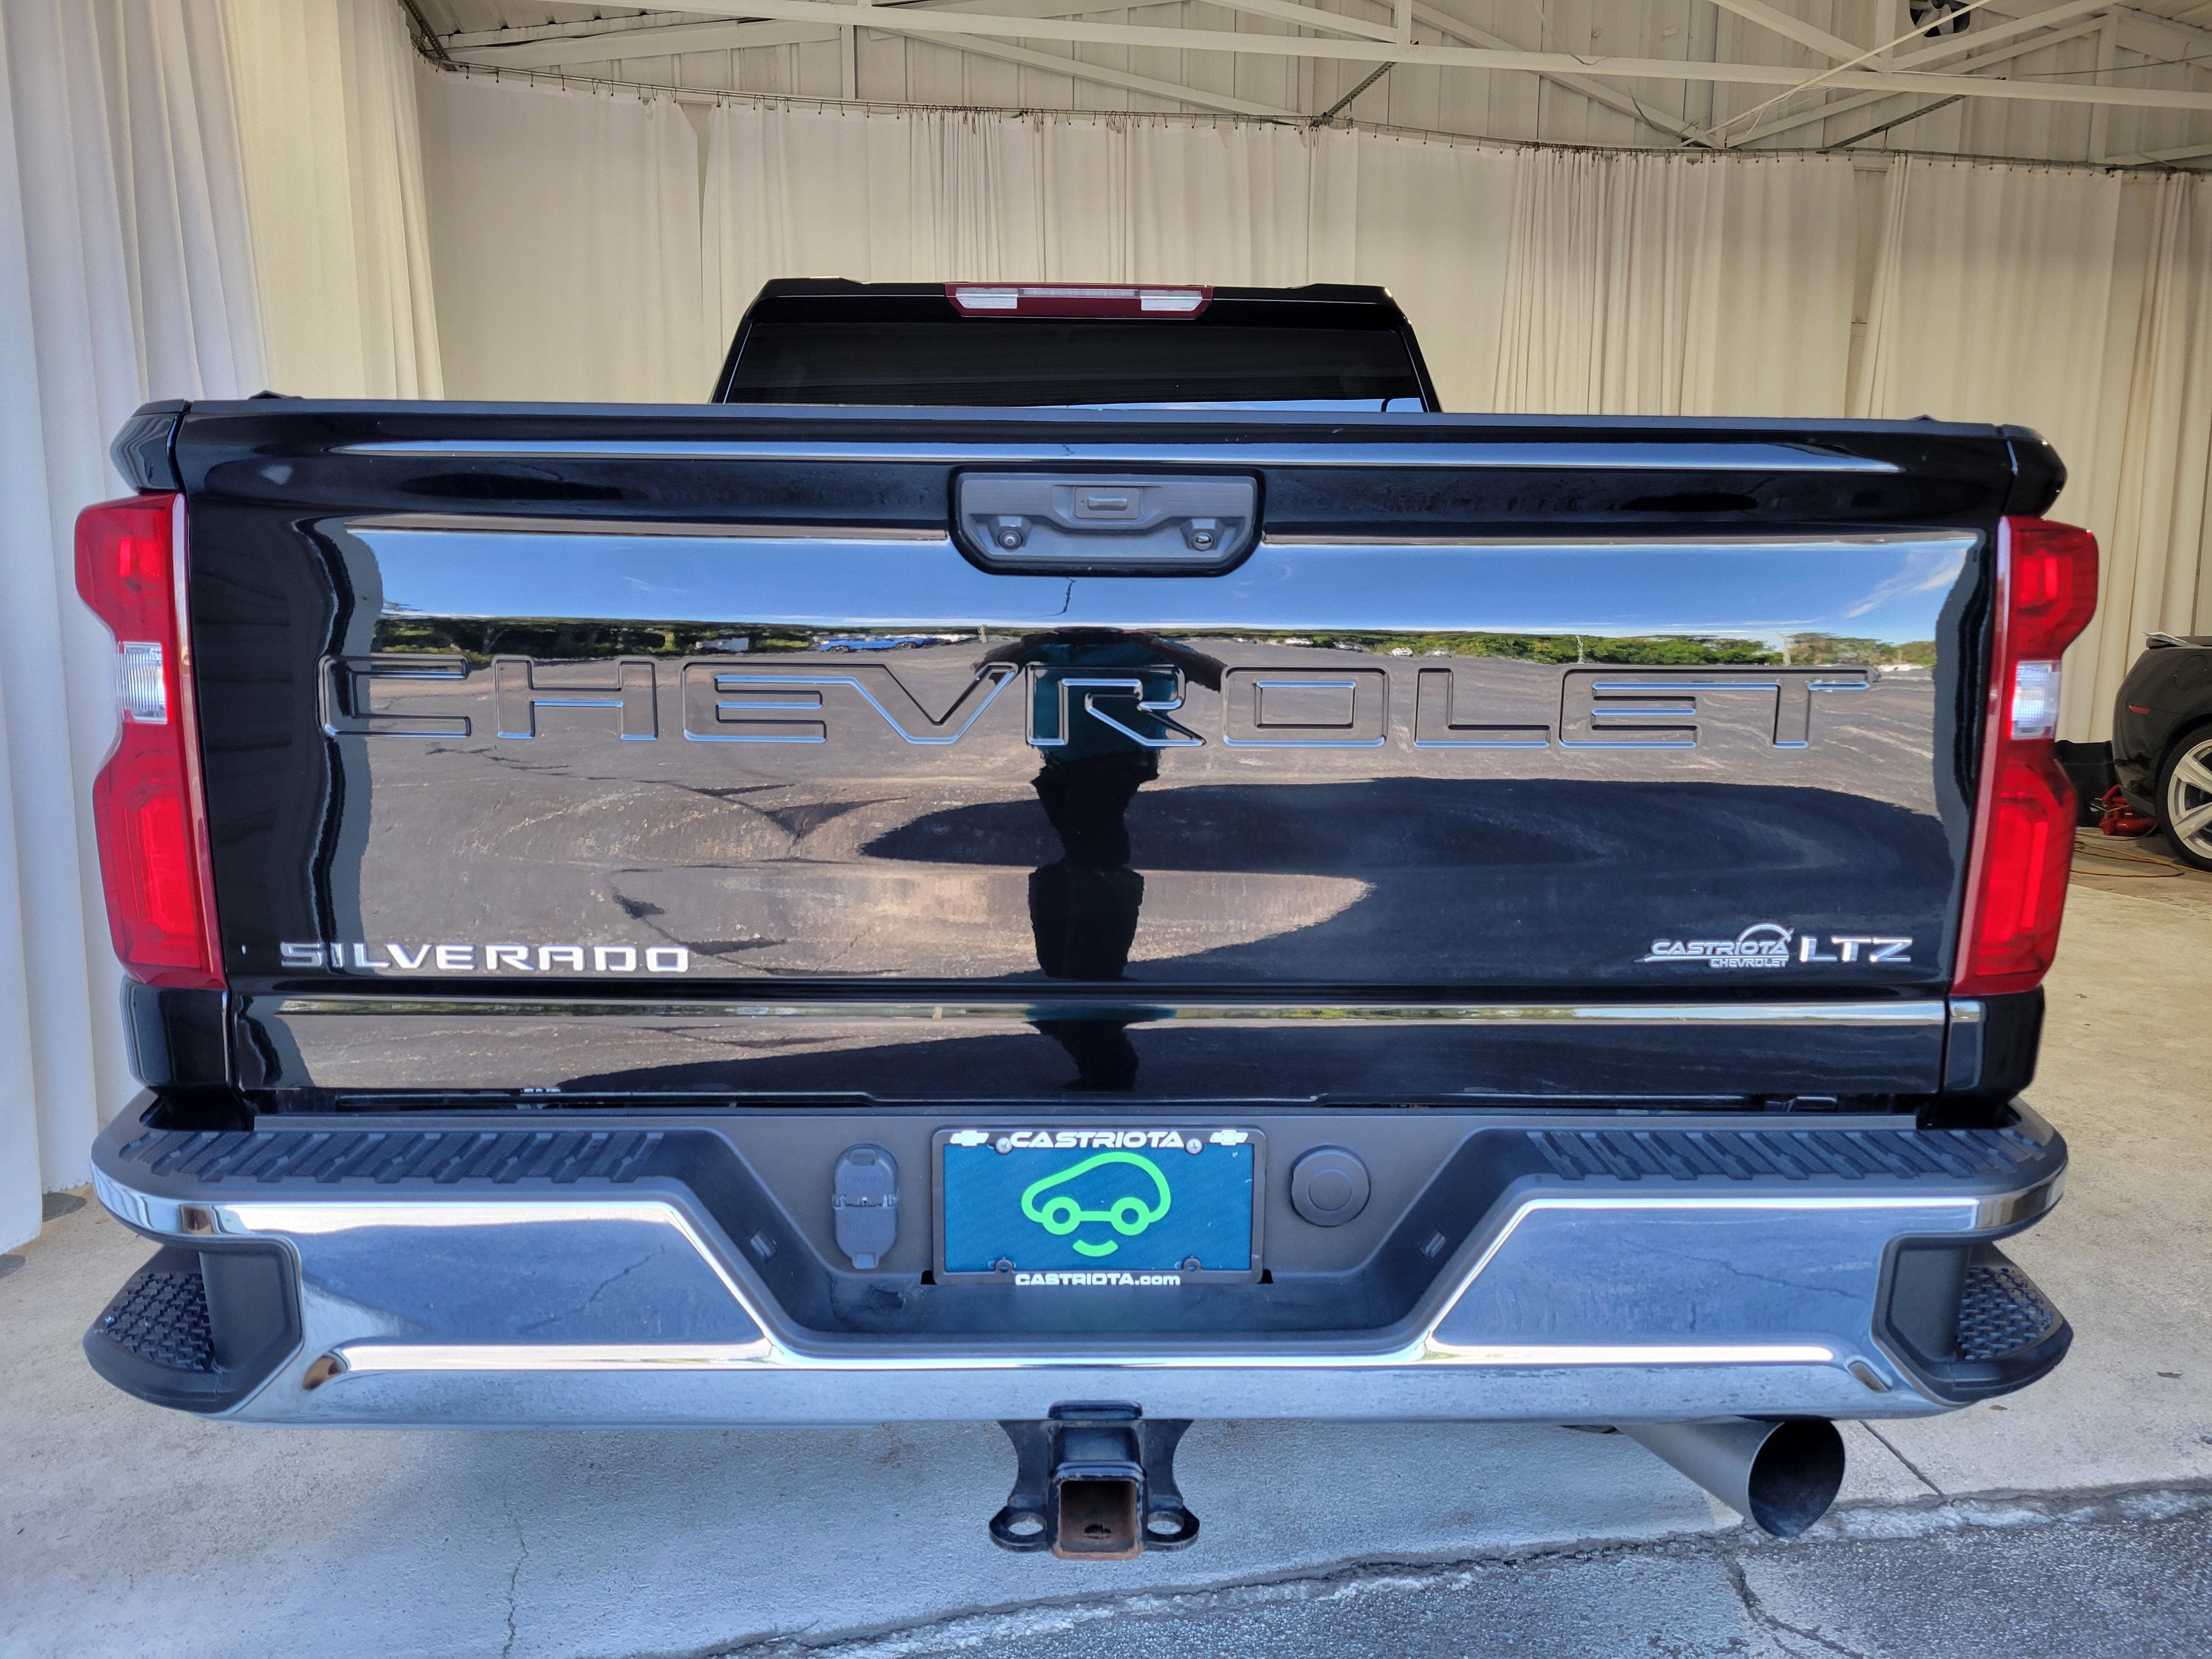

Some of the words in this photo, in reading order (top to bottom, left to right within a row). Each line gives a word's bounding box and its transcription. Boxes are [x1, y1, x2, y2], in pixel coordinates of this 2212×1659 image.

[319, 654, 1876, 748] CHEVROLET
[1651, 938, 1788, 955] CASTRIOTA
[1799, 935, 1913, 963] LTZ
[279, 941, 691, 973] SILVERADO
[1709, 958, 1788, 968] CHEVROLET
[1009, 1131, 1185, 1148] CASTRIOTA
[1015, 1273, 1181, 1286] CASTRIOTA.com
